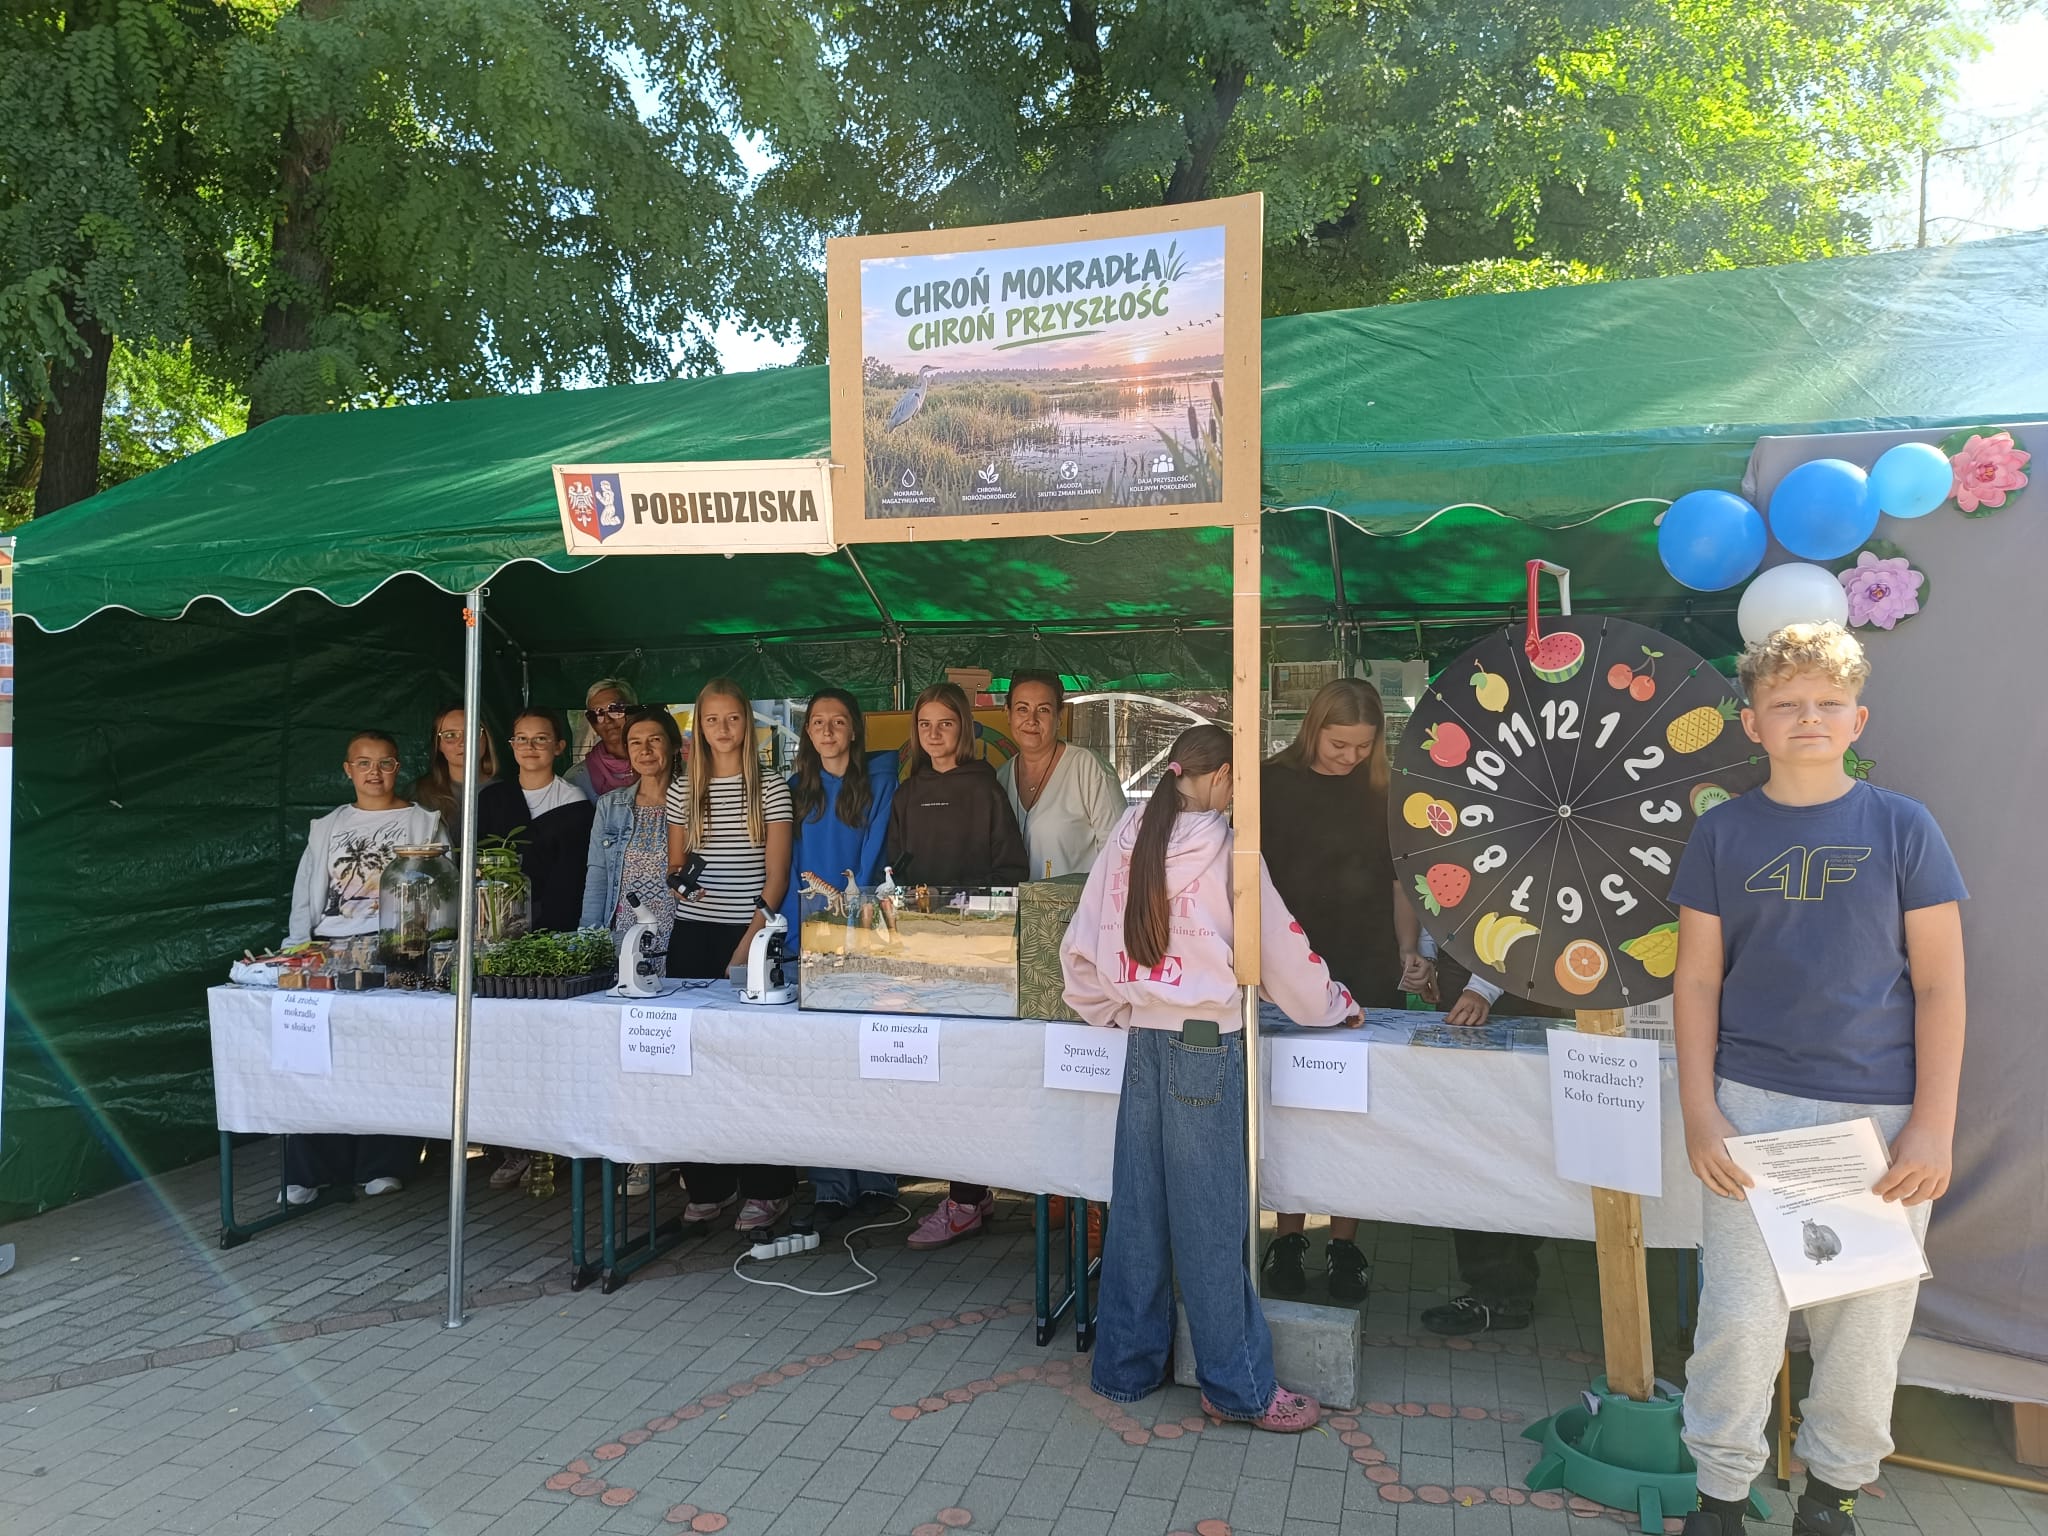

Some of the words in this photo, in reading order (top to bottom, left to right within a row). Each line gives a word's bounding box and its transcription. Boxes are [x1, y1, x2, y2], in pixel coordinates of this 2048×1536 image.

[895, 267, 990, 317] CHROŃ
[1001, 249, 1162, 302] MOKRADŁA
[908, 309, 994, 351] CHROŃ
[1006, 280, 1169, 338] PRZYSZŁOŚĆ
[976, 486, 1001, 494] CHRONIĄ
[1056, 482, 1082, 490] ŁAGODZĄ
[1129, 484, 1159, 492] KOLEJNYM
[1159, 482, 1197, 491] POKOLENIOM
[1153, 474, 1189, 484] PRZYSZŁOŚĆ
[1037, 490, 1057, 498] SKUTKI
[1058, 489, 1077, 497] ZMIAN
[1077, 488, 1102, 496] KLIMATU
[630, 490, 819, 525] POBIEDZISKA
[1540, 700, 1580, 740] 12
[1595, 711, 1621, 748] 1
[1498, 711, 1536, 757] 11
[1466, 750, 1506, 791] 10
[1623, 746, 1665, 781] 2
[1459, 804, 1495, 828] 9
[1639, 799, 1682, 824] 3
[1472, 844, 1508, 874] 8
[1629, 846, 1672, 875] 4
[1744, 845, 1872, 901] 4F
[1509, 875, 1534, 912] 7
[1600, 873, 1638, 915] 5
[1556, 886, 1583, 924] 6
[1198, 927, 1216, 937] for
[1114, 950, 1183, 987] ME
[284, 994, 297, 1003] Jak
[630, 1007, 644, 1019] Co
[646, 1010, 677, 1021] można
[291, 1021, 316, 1033] słoiku?
[628, 1025, 672, 1040] zobaczyć
[872, 1022, 889, 1033] Kto
[891, 1023, 928, 1034] mieszka
[628, 1044, 637, 1052] w
[639, 1042, 676, 1056] bagnie?
[893, 1040, 905, 1049] na
[1063, 1044, 1109, 1061] Sprawdź,
[1291, 1055, 1348, 1073] Memory
[1567, 1048, 1585, 1063] Co
[1589, 1052, 1626, 1068] wiesz
[1629, 1059, 1638, 1069] o
[1060, 1063, 1072, 1072] co
[1074, 1063, 1111, 1077] czujesz
[1563, 1068, 1644, 1089] mokradłach?
[1563, 1087, 1594, 1103] Koło
[1597, 1092, 1645, 1112] fortuny
